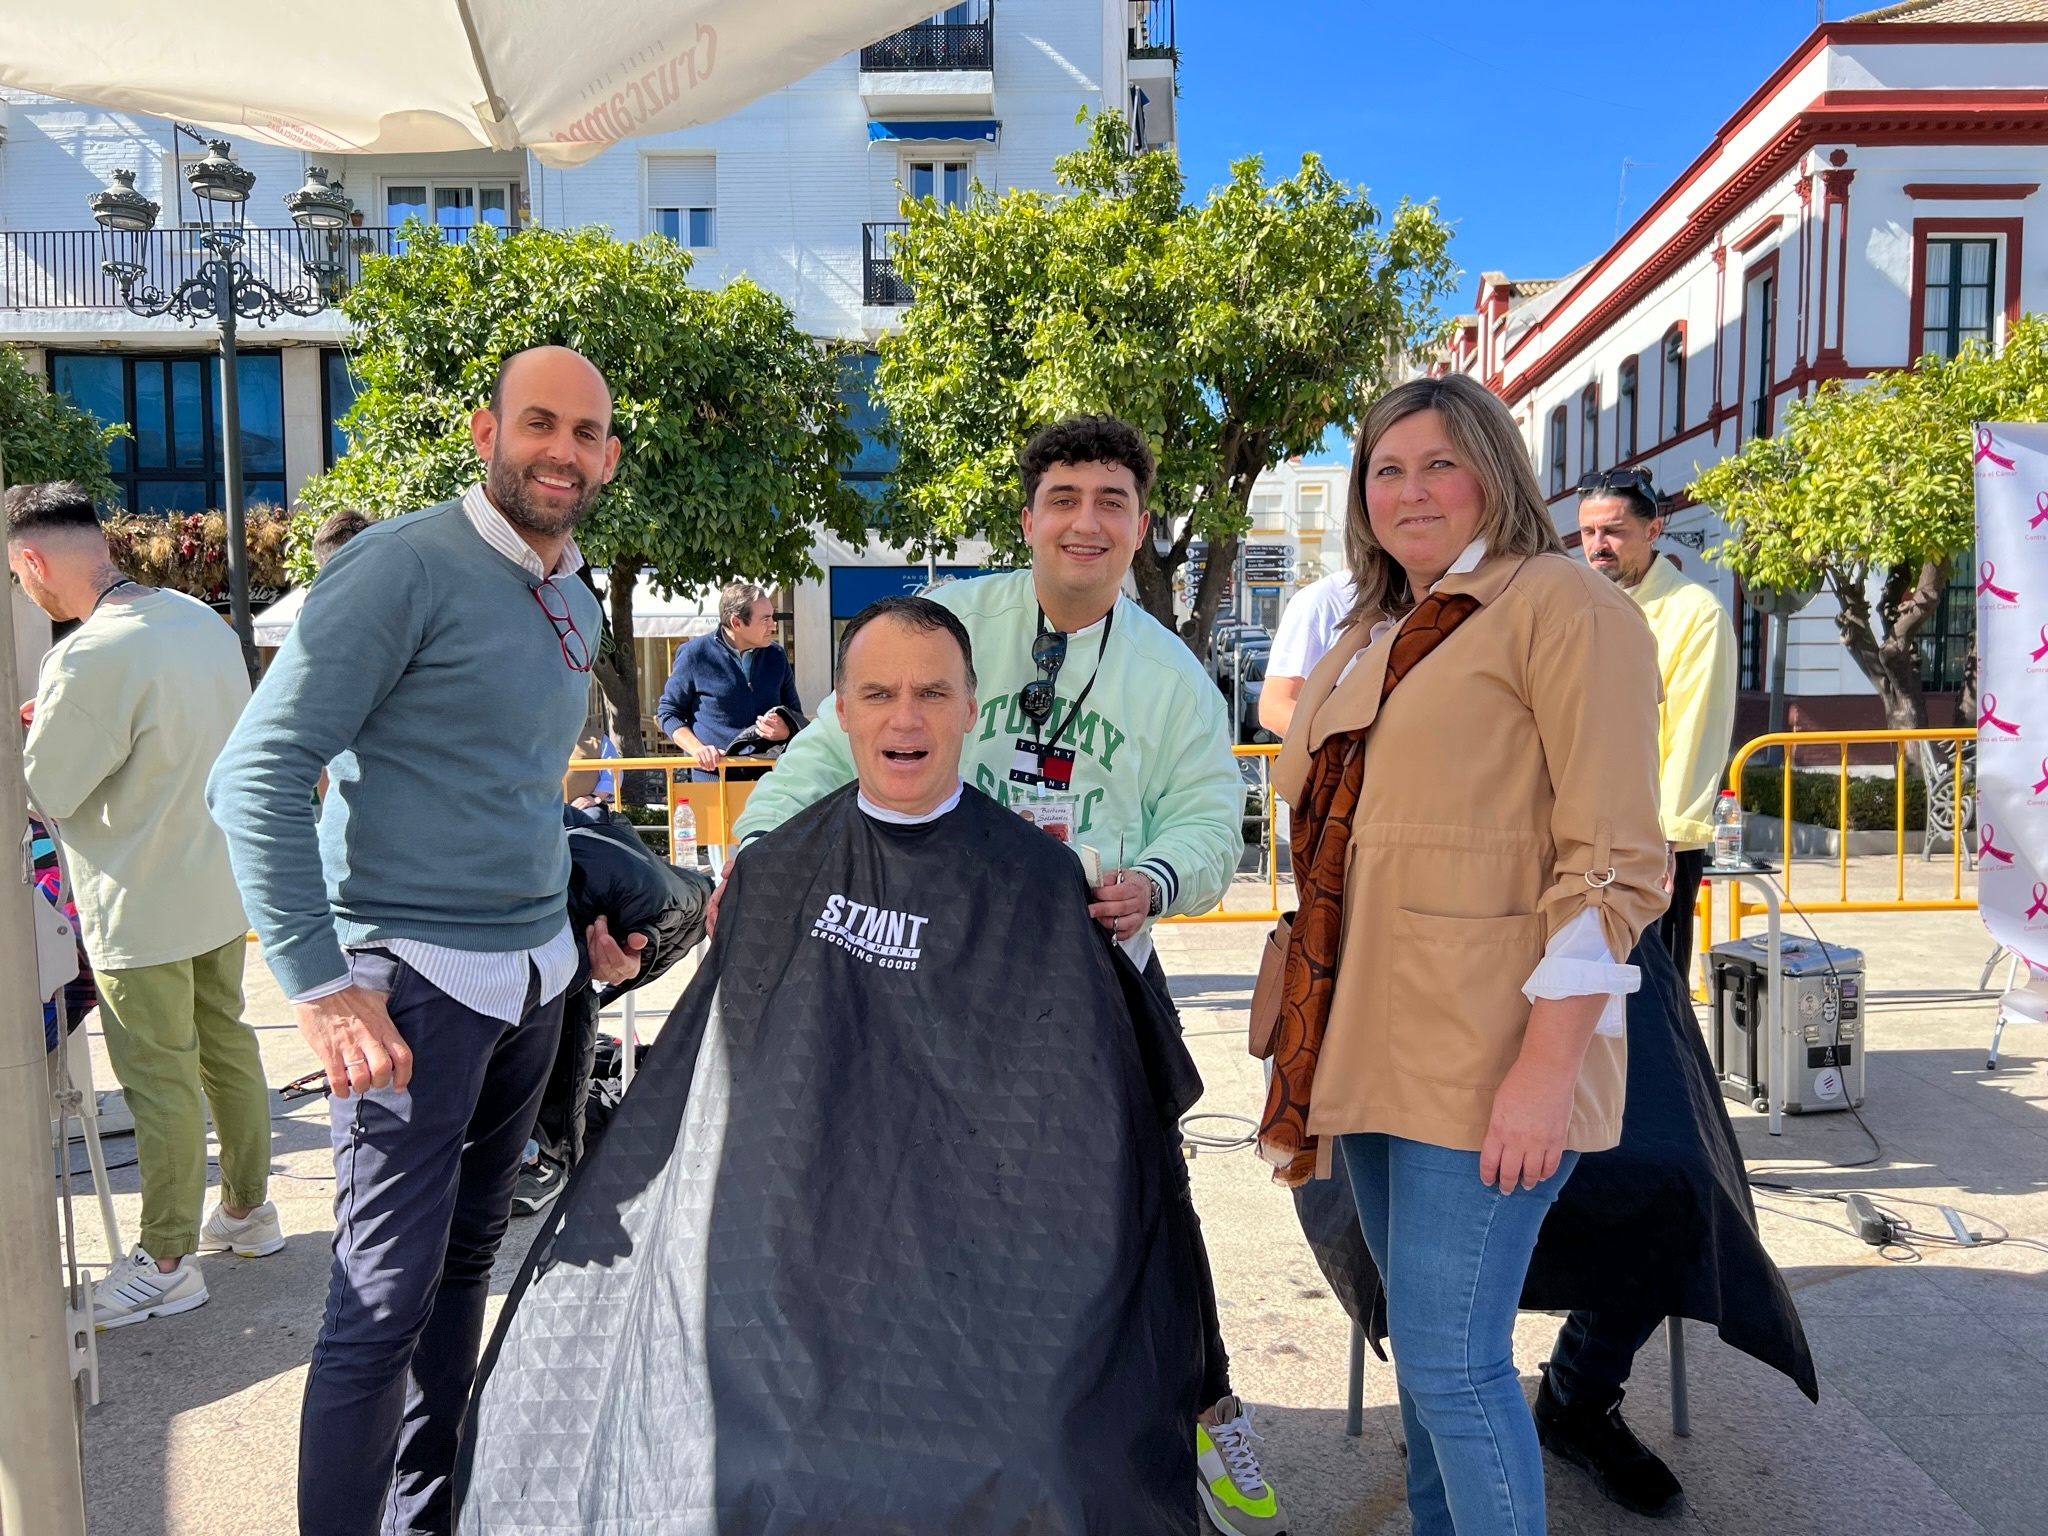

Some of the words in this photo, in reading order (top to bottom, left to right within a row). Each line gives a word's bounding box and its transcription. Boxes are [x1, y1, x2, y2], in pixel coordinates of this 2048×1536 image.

[1019, 741, 1072, 759] TOMY
[1013, 773, 1067, 789] JENS
[821, 894, 929, 949] STMNT
[810, 928, 874, 964] GROOMING
[878, 958, 918, 971] GOODS
[822, 922, 915, 957] STATEMENT
